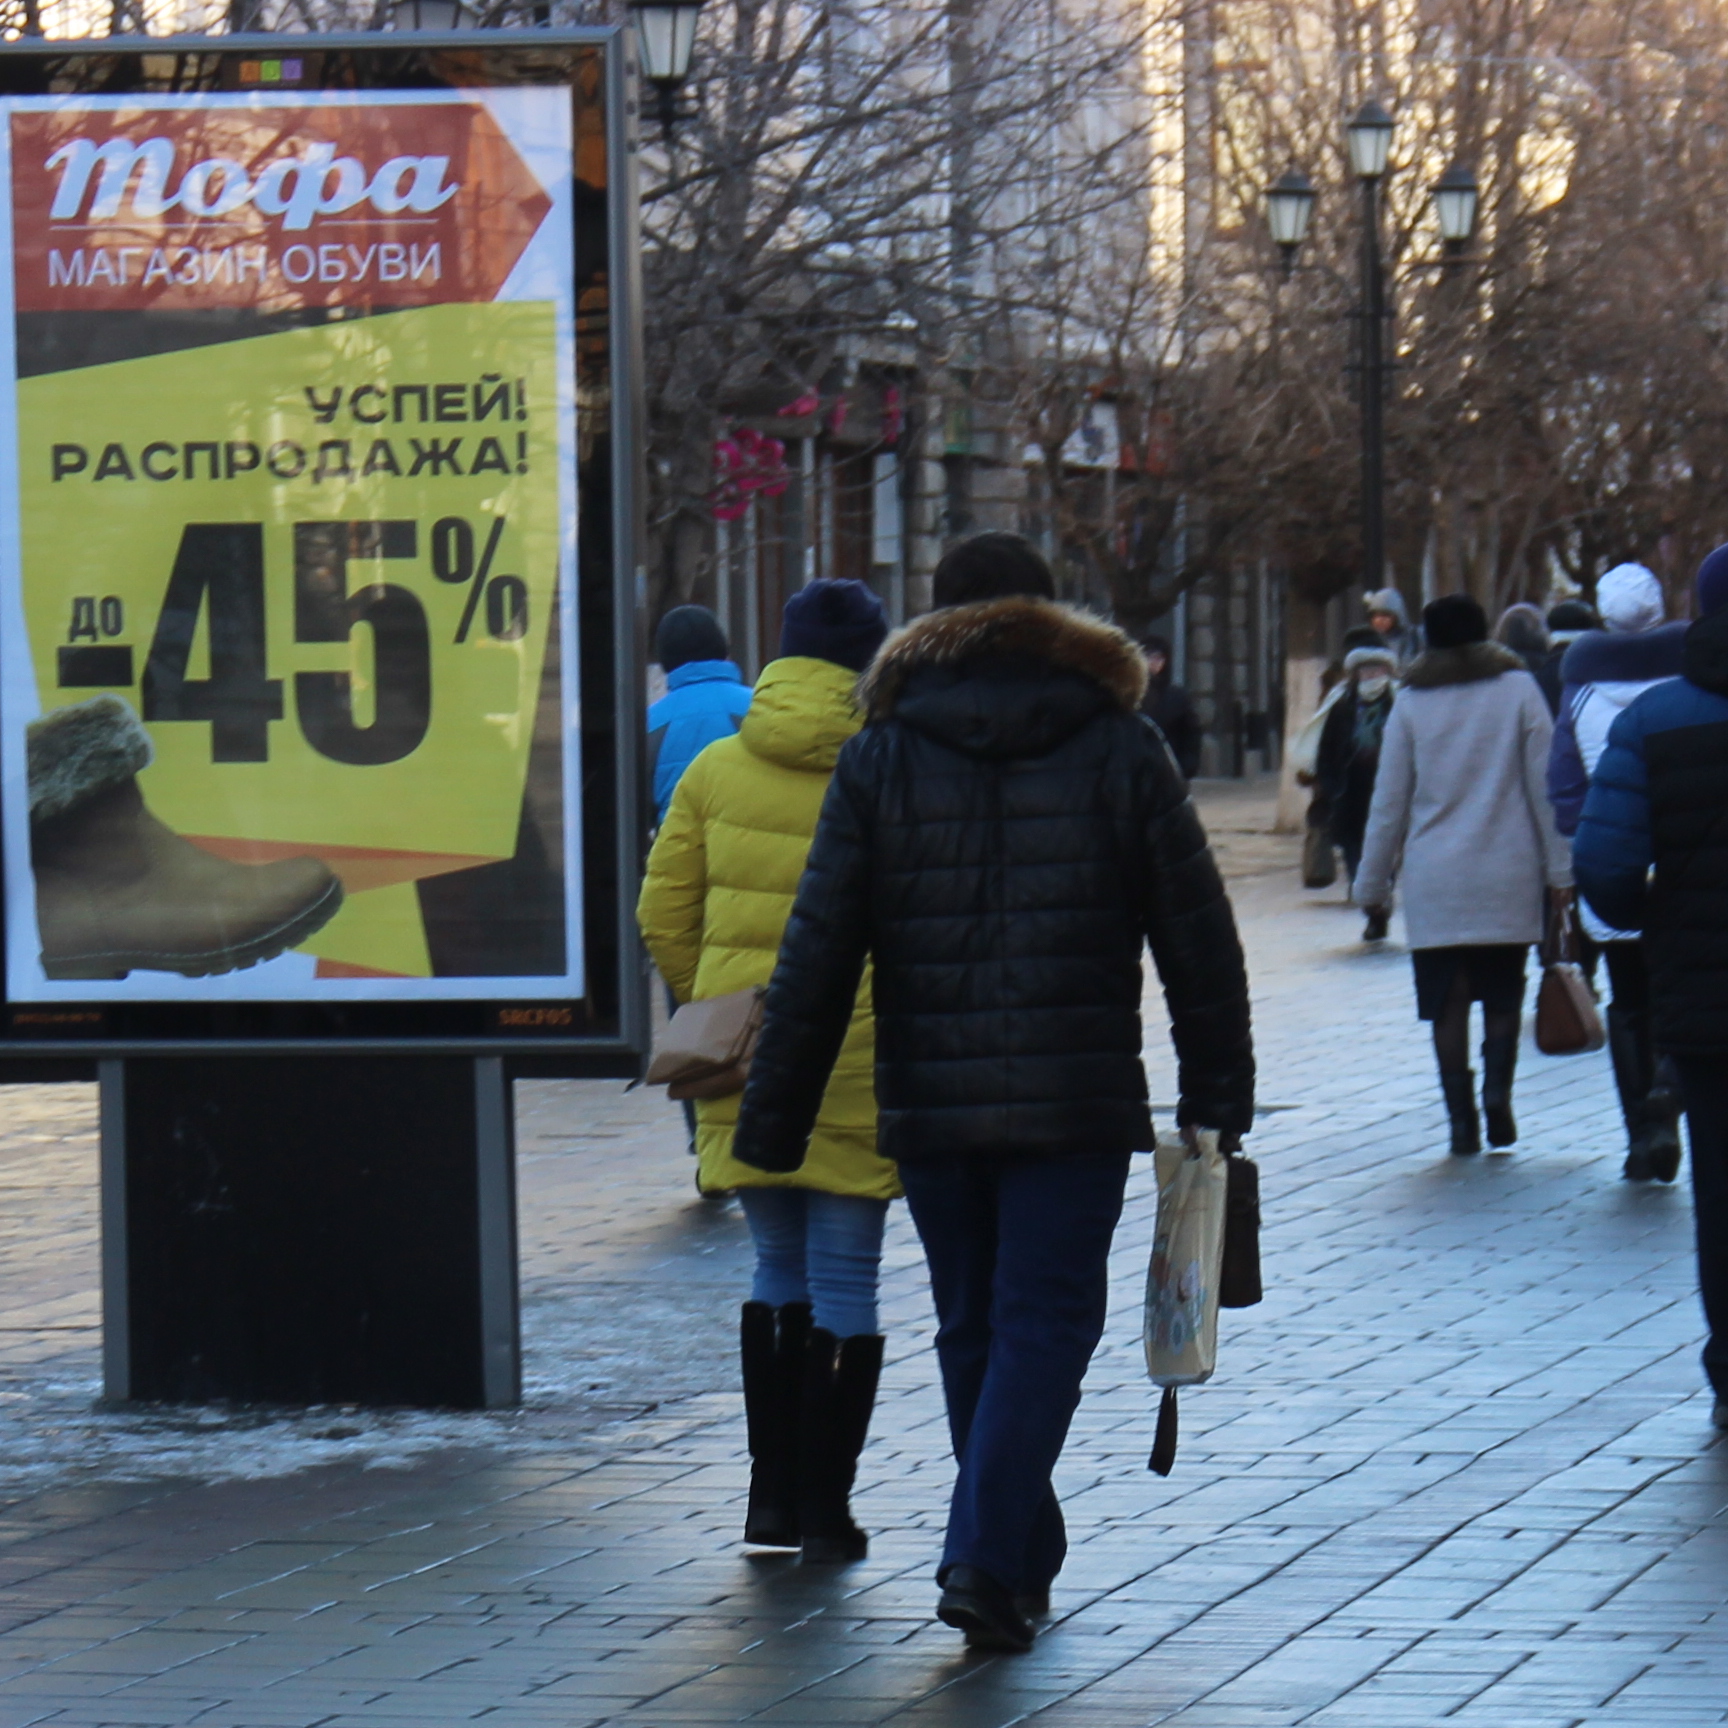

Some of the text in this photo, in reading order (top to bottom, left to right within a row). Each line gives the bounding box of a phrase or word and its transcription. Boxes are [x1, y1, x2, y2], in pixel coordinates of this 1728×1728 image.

[48, 242, 443, 287] МАГАЗИН ОБУВИ
[304, 373, 529, 424] УСПЕЙ!
[51, 431, 530, 485] РАСПРОДАЖА!
